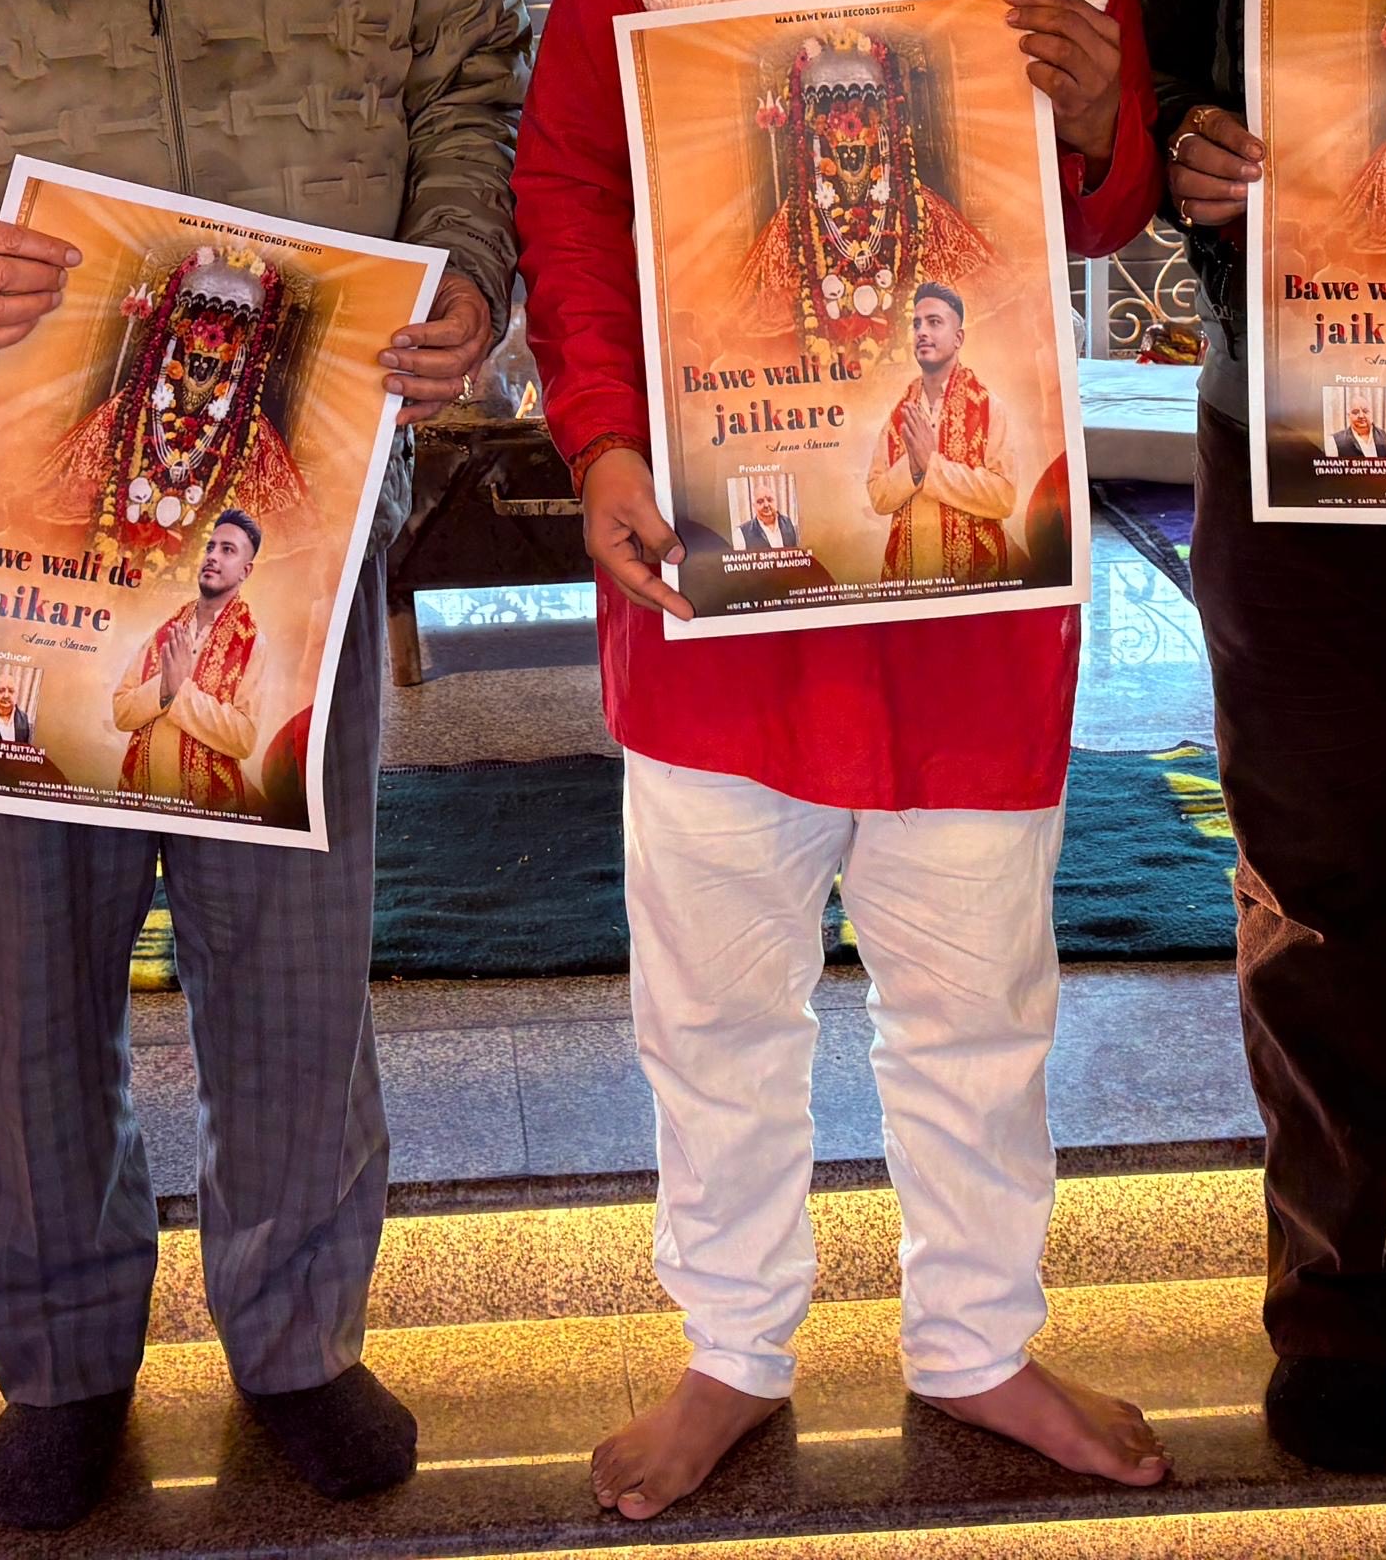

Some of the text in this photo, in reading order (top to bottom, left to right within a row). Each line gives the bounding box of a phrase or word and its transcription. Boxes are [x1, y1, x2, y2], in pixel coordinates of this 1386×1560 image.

[1284, 274, 1359, 300] Bawe
[682, 352, 862, 393] Bawe wali de
[1335, 375, 1379, 383] Producer
[711, 399, 845, 446] jaikare
[739, 464, 781, 473] Producer
[1313, 459, 1350, 467] MAHANT
[1352, 459, 1374, 467] SHRI
[1345, 468, 1368, 476] FORT
[721, 553, 757, 563] MAHANT
[759, 551, 779, 560] SHRI
[781, 550, 803, 559] BITTA
[42, 550, 104, 583] wali
[109, 557, 142, 589] de
[753, 561, 774, 570] FORT
[776, 558, 811, 568] MANDIR)
[11, 744, 36, 754] BITTA
[5, 753, 44, 765] MANDIR)
